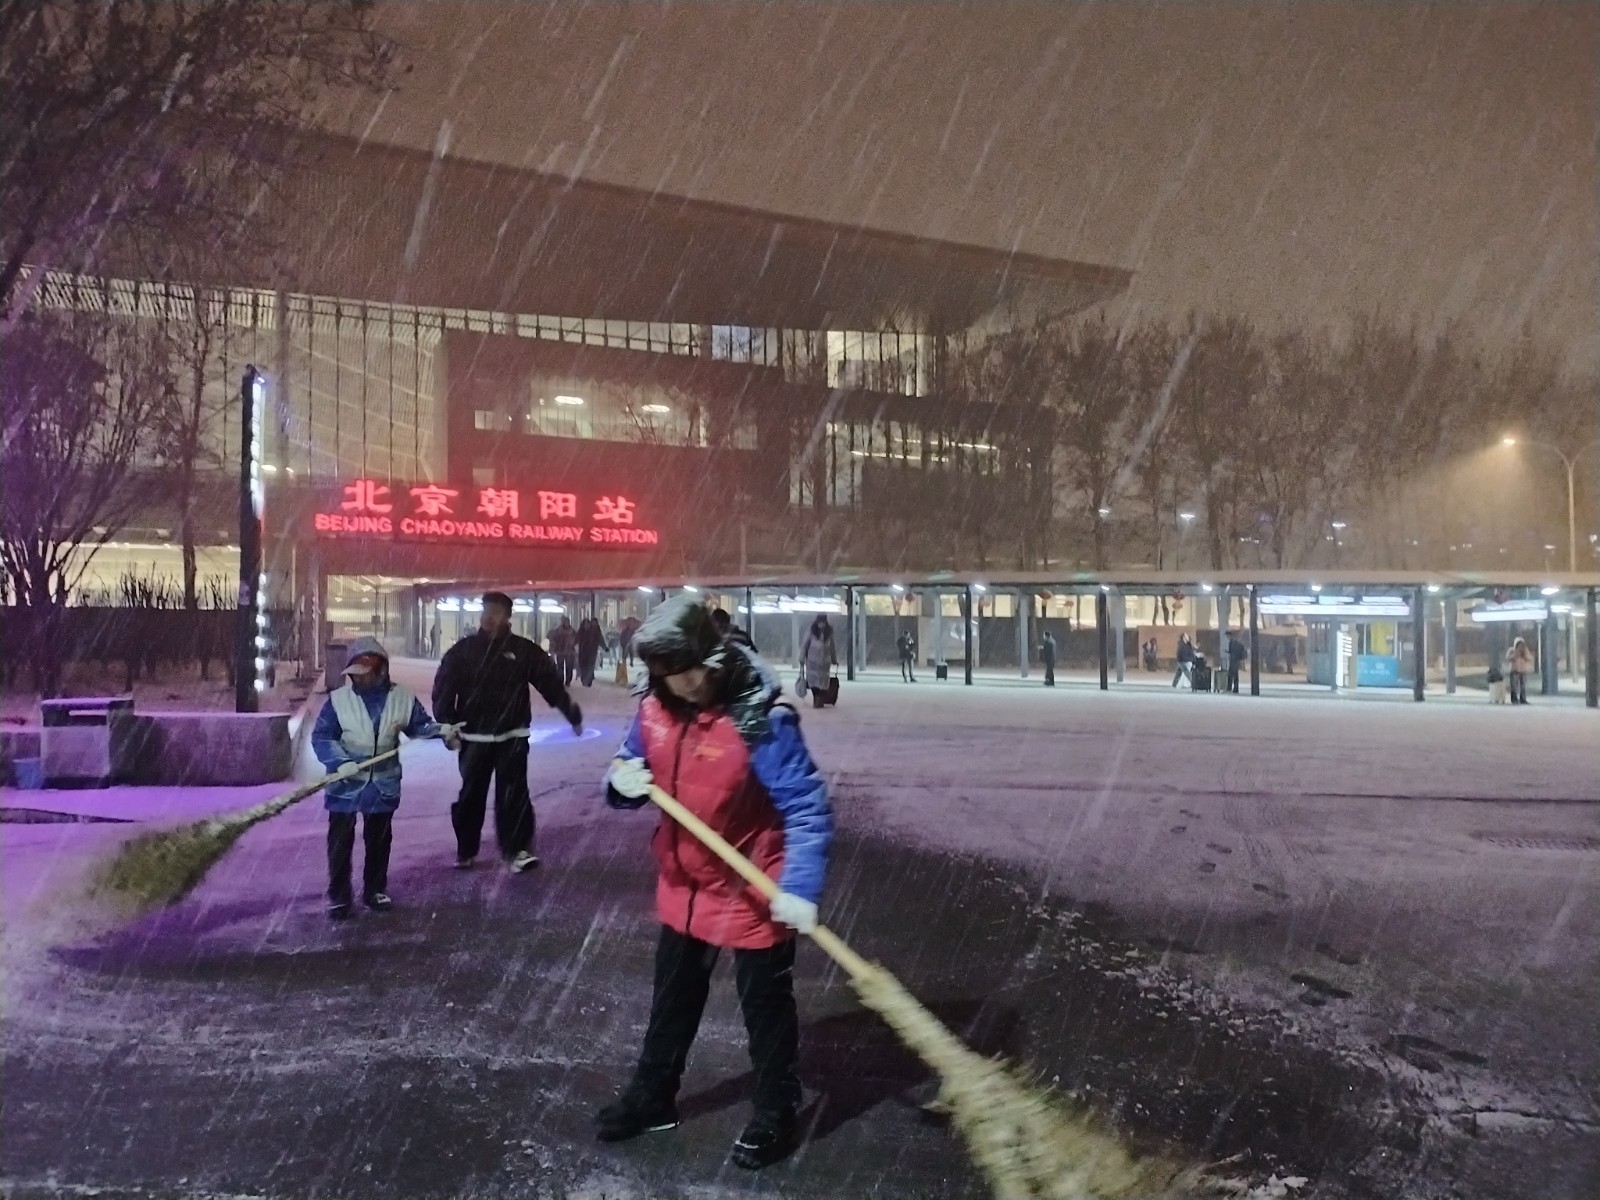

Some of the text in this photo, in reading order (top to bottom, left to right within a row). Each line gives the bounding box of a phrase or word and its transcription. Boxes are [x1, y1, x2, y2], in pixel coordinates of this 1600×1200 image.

[342, 480, 636, 524] 北京朝阳站
[315, 513, 658, 545] BEIJING CHAOYANG RAILWAY STATION
